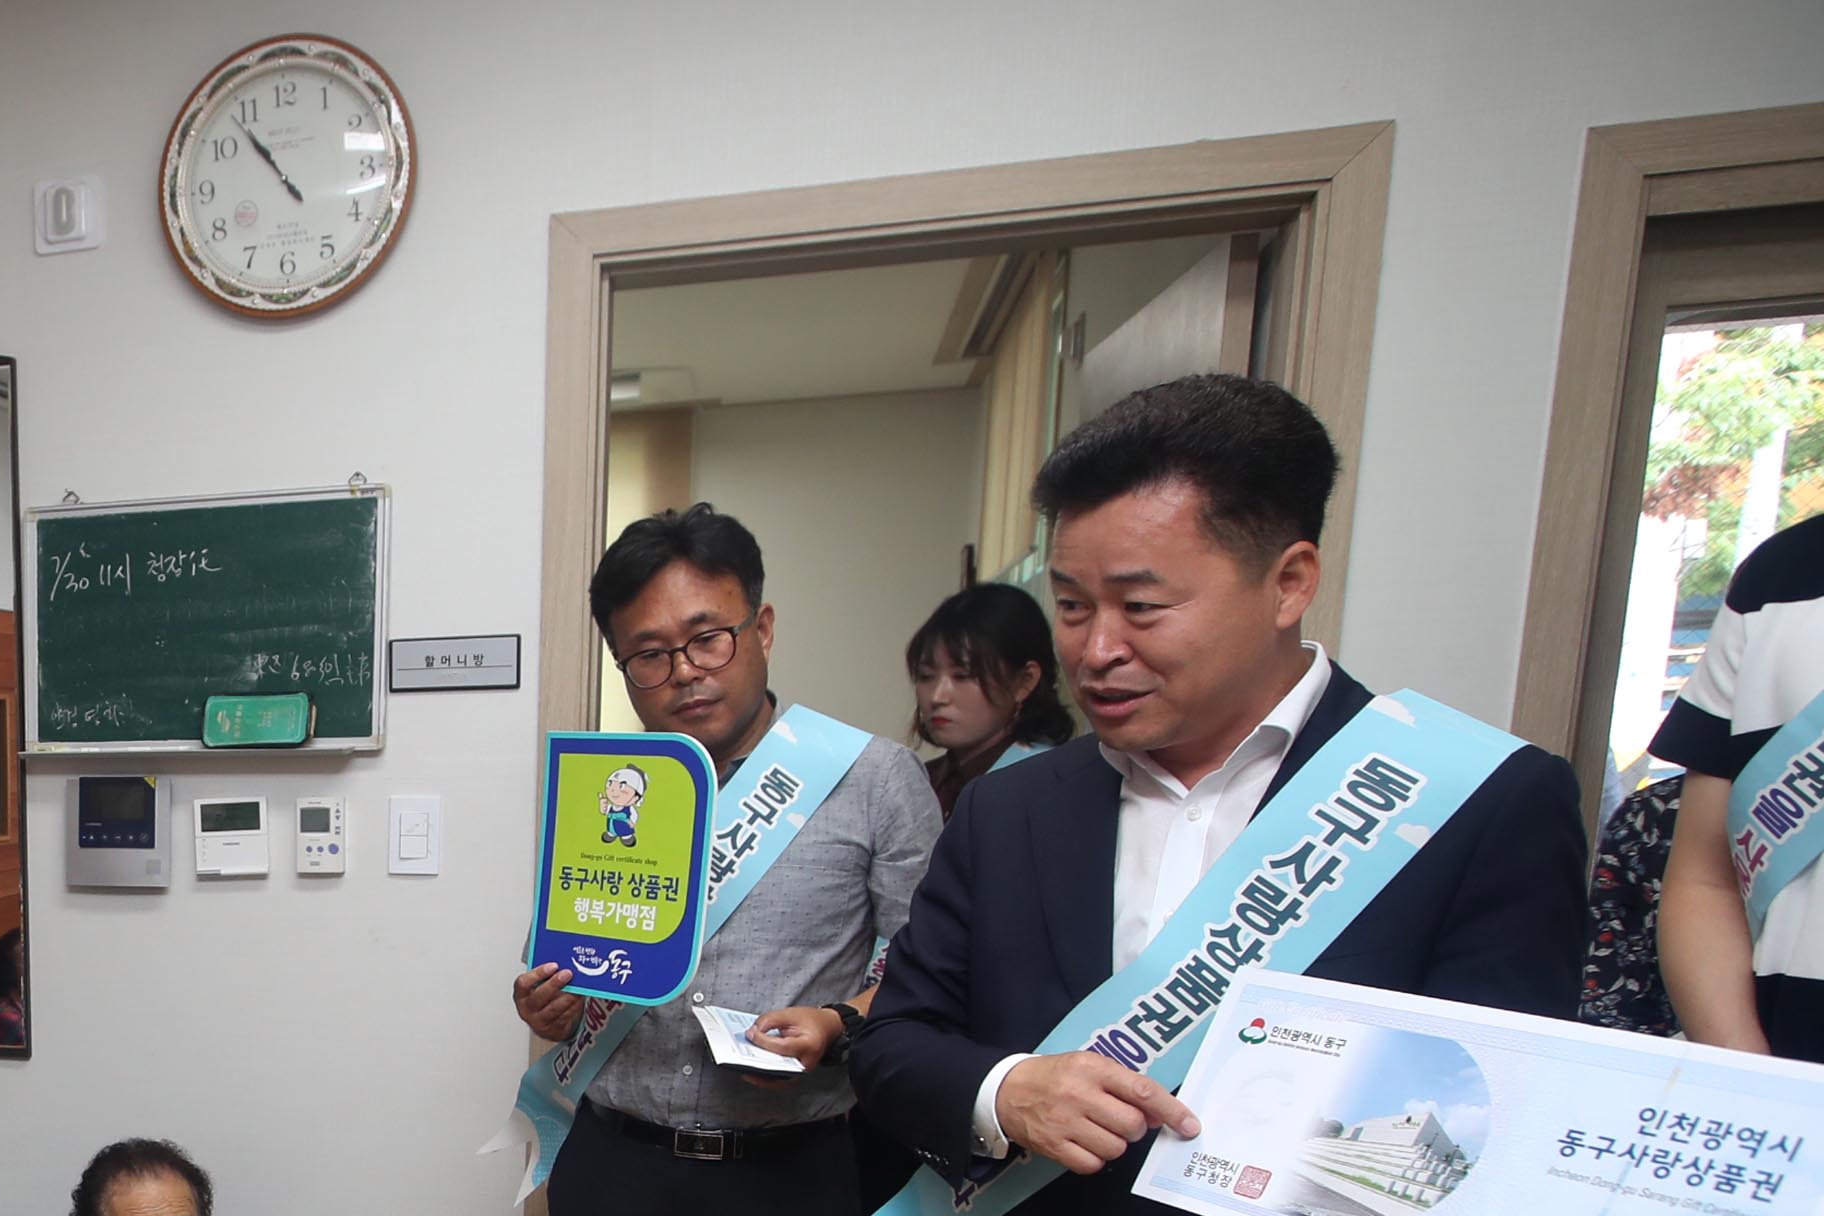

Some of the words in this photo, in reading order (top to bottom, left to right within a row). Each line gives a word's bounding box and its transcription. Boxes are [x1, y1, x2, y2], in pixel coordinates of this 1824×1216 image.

[273, 82, 298, 108] 12
[319, 86, 328, 110] 1
[239, 98, 259, 124] 11
[212, 137, 238, 161] 10
[359, 156, 375, 180] 3
[198, 180, 216, 204] 9
[346, 199, 362, 221] 4
[211, 217, 227, 241] 8
[243, 246, 257, 269] 7
[319, 235, 335, 259] 5
[280, 251, 296, 274] 6
[424, 653, 484, 668] 할머니방
[709, 767, 800, 901] 동구사랑
[559, 866, 623, 896] 동구사랑
[627, 873, 680, 902] 상품권
[574, 897, 658, 931] 행복가맹점
[608, 949, 633, 985] 동구
[1270, 1026, 1323, 1046] 인천광역시
[1324, 1036, 1347, 1050] 동구
[1637, 1106, 1804, 1163] 인천광역시
[1183, 1160, 1233, 1188] 동구청장
[1191, 1151, 1241, 1175] 인천광역시
[1547, 1166, 1590, 1184] Incheon
[1557, 1128, 1785, 1204] 동구사랑상품권
